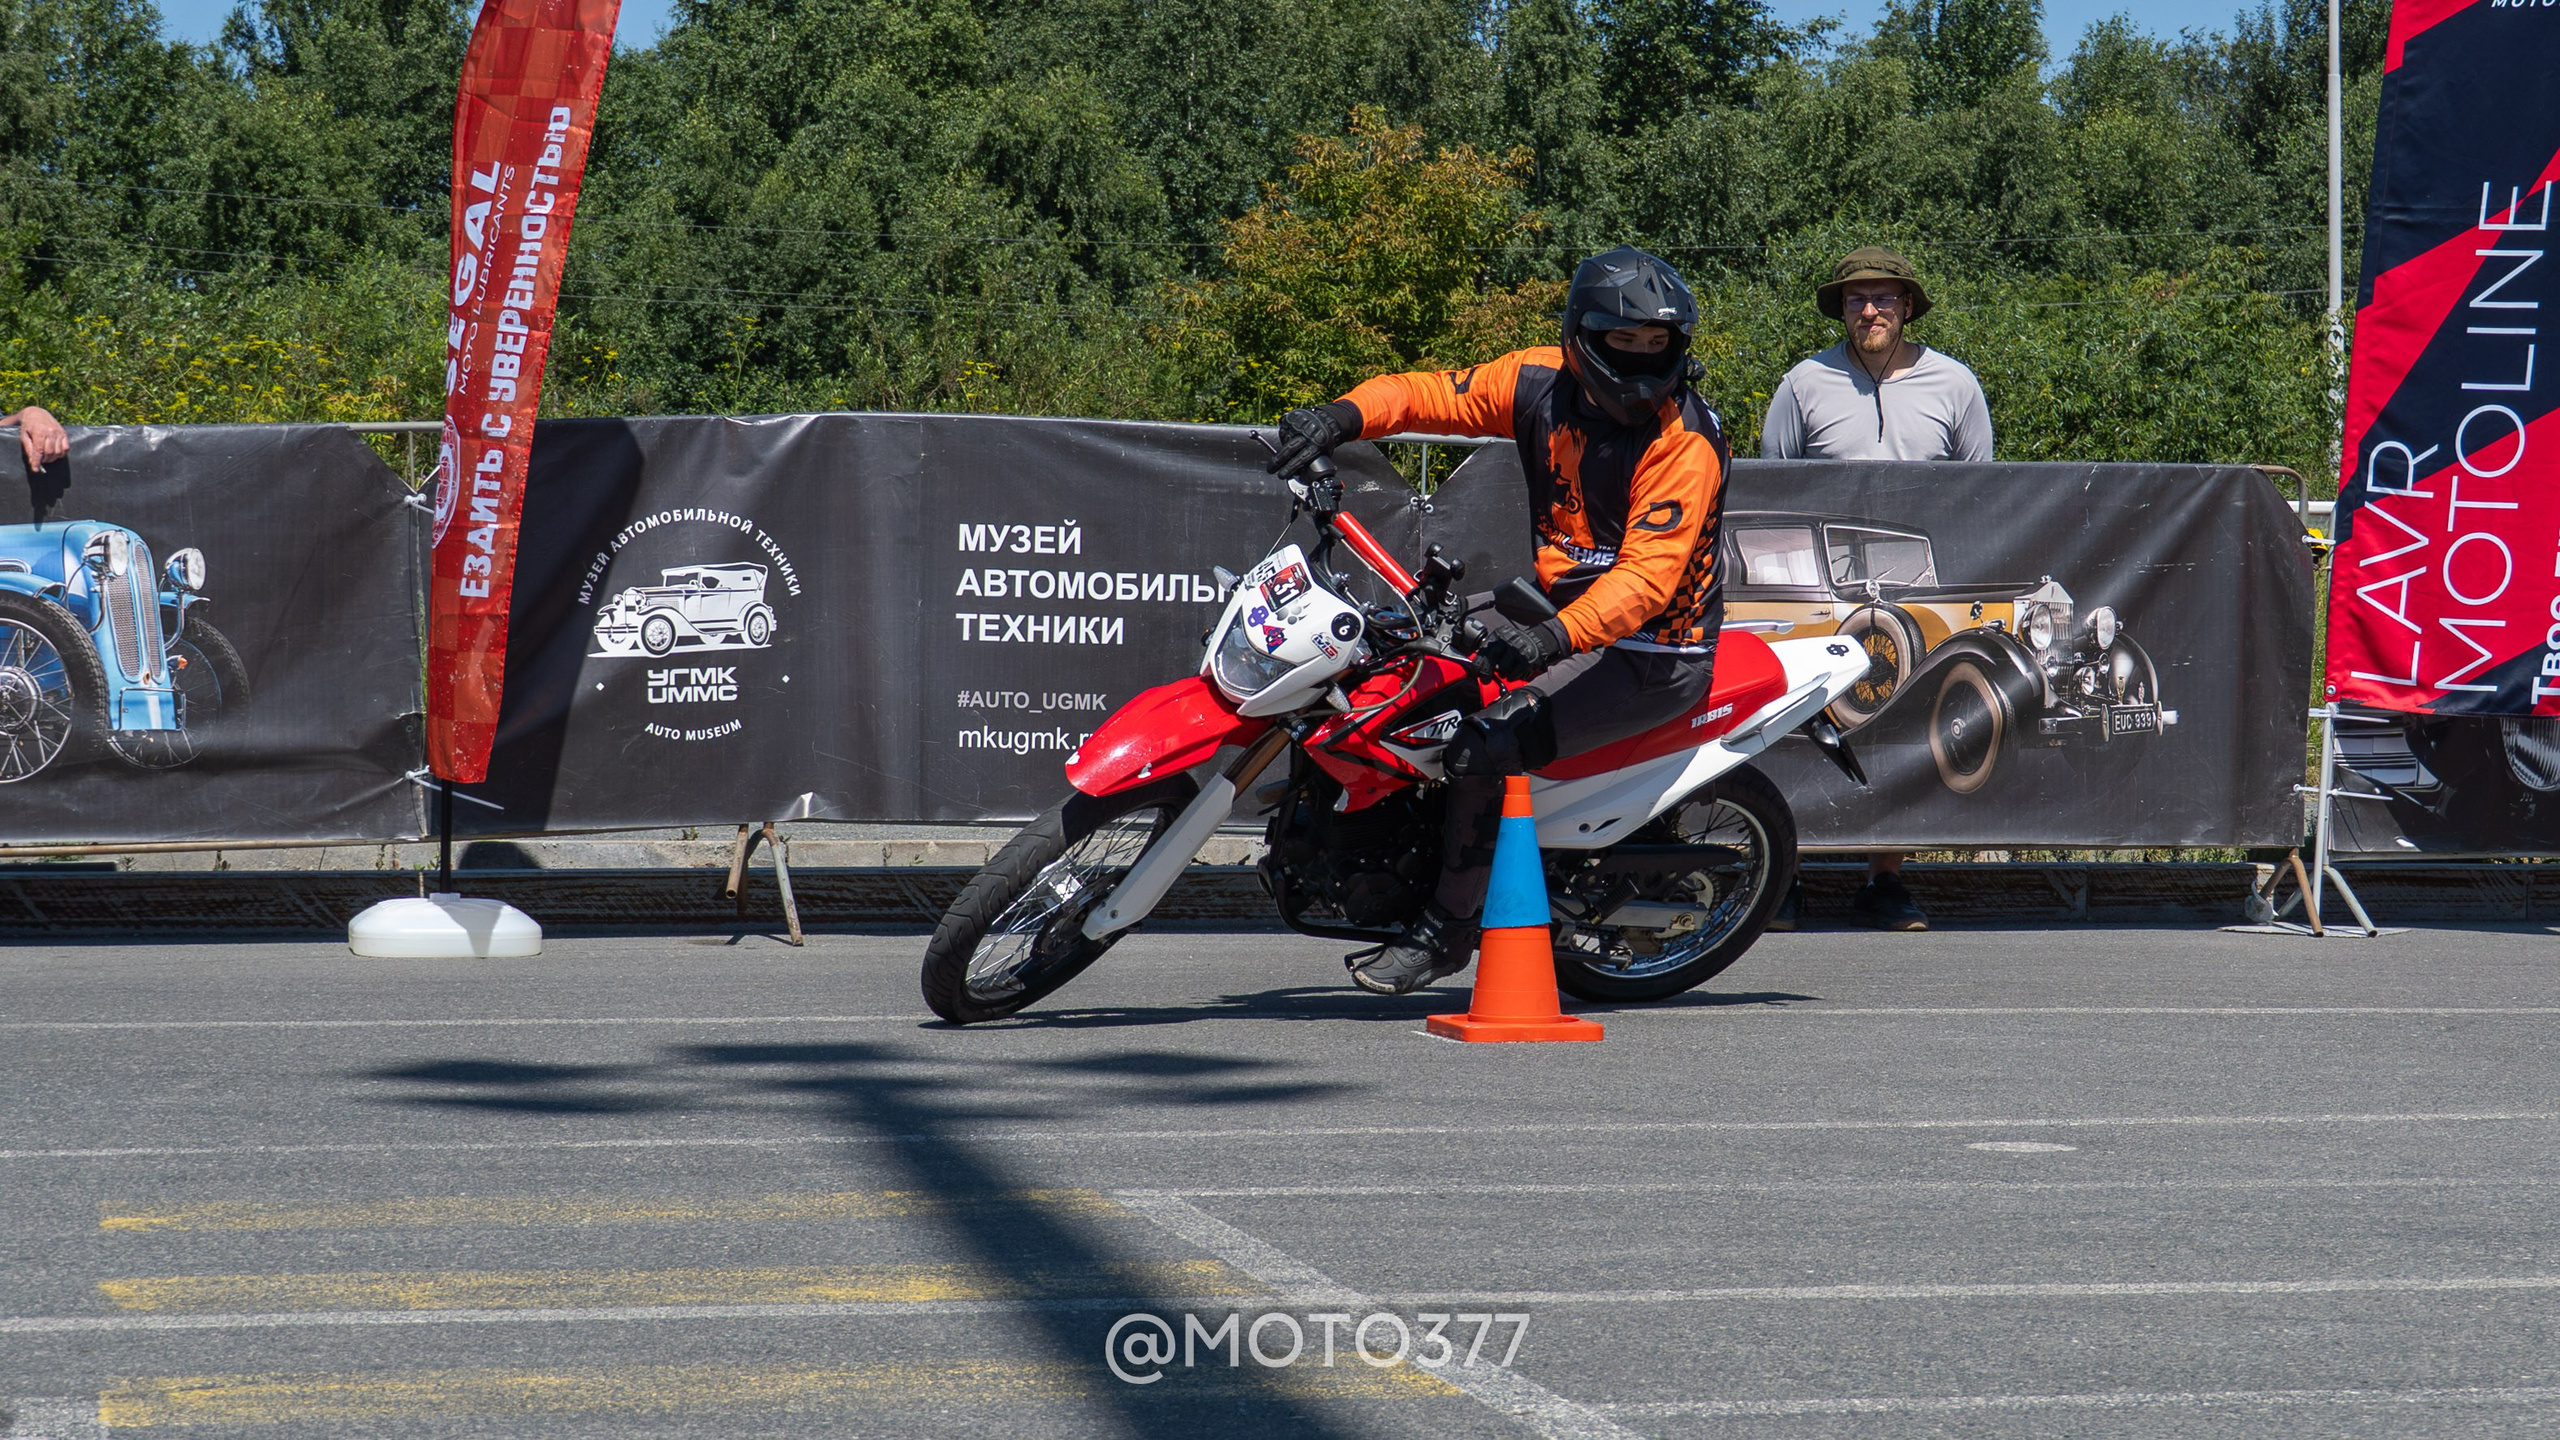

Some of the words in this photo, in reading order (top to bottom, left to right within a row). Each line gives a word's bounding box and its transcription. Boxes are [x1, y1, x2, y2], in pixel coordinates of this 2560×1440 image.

[488, 106, 571, 402] УВЕРЕННОСТЬЮ
[458, 322, 478, 395] MOTO
[472, 165, 516, 316] LUBRICANTS
[481, 413, 512, 438] С
[2434, 180, 2552, 692] MOTOLINE
[460, 450, 504, 598] ЕЗДИТЬ
[958, 519, 1082, 555] МУЗЕЙ
[578, 552, 610, 605] МУЗЕЙ
[610, 508, 753, 553] АВТОМОБИЛЬНОЙ
[755, 529, 802, 597] ТЕХНИКИ
[2350, 440, 2439, 687] LAVR
[955, 613, 1124, 645] ТЕХНИКИ
[648, 667, 738, 686] УГМК
[648, 685, 738, 703] UMMC
[957, 690, 1107, 713] #AUTO_UGMK
[645, 722, 681, 740] AUTO
[685, 718, 742, 741] MUSEUM
[1430, 715, 1459, 737] TTR
[1691, 703, 1734, 729] IRBIS
[2114, 715, 2132, 731] EUC
[2134, 713, 2152, 728] 939
[958, 726, 1094, 755] mkugmk.r
